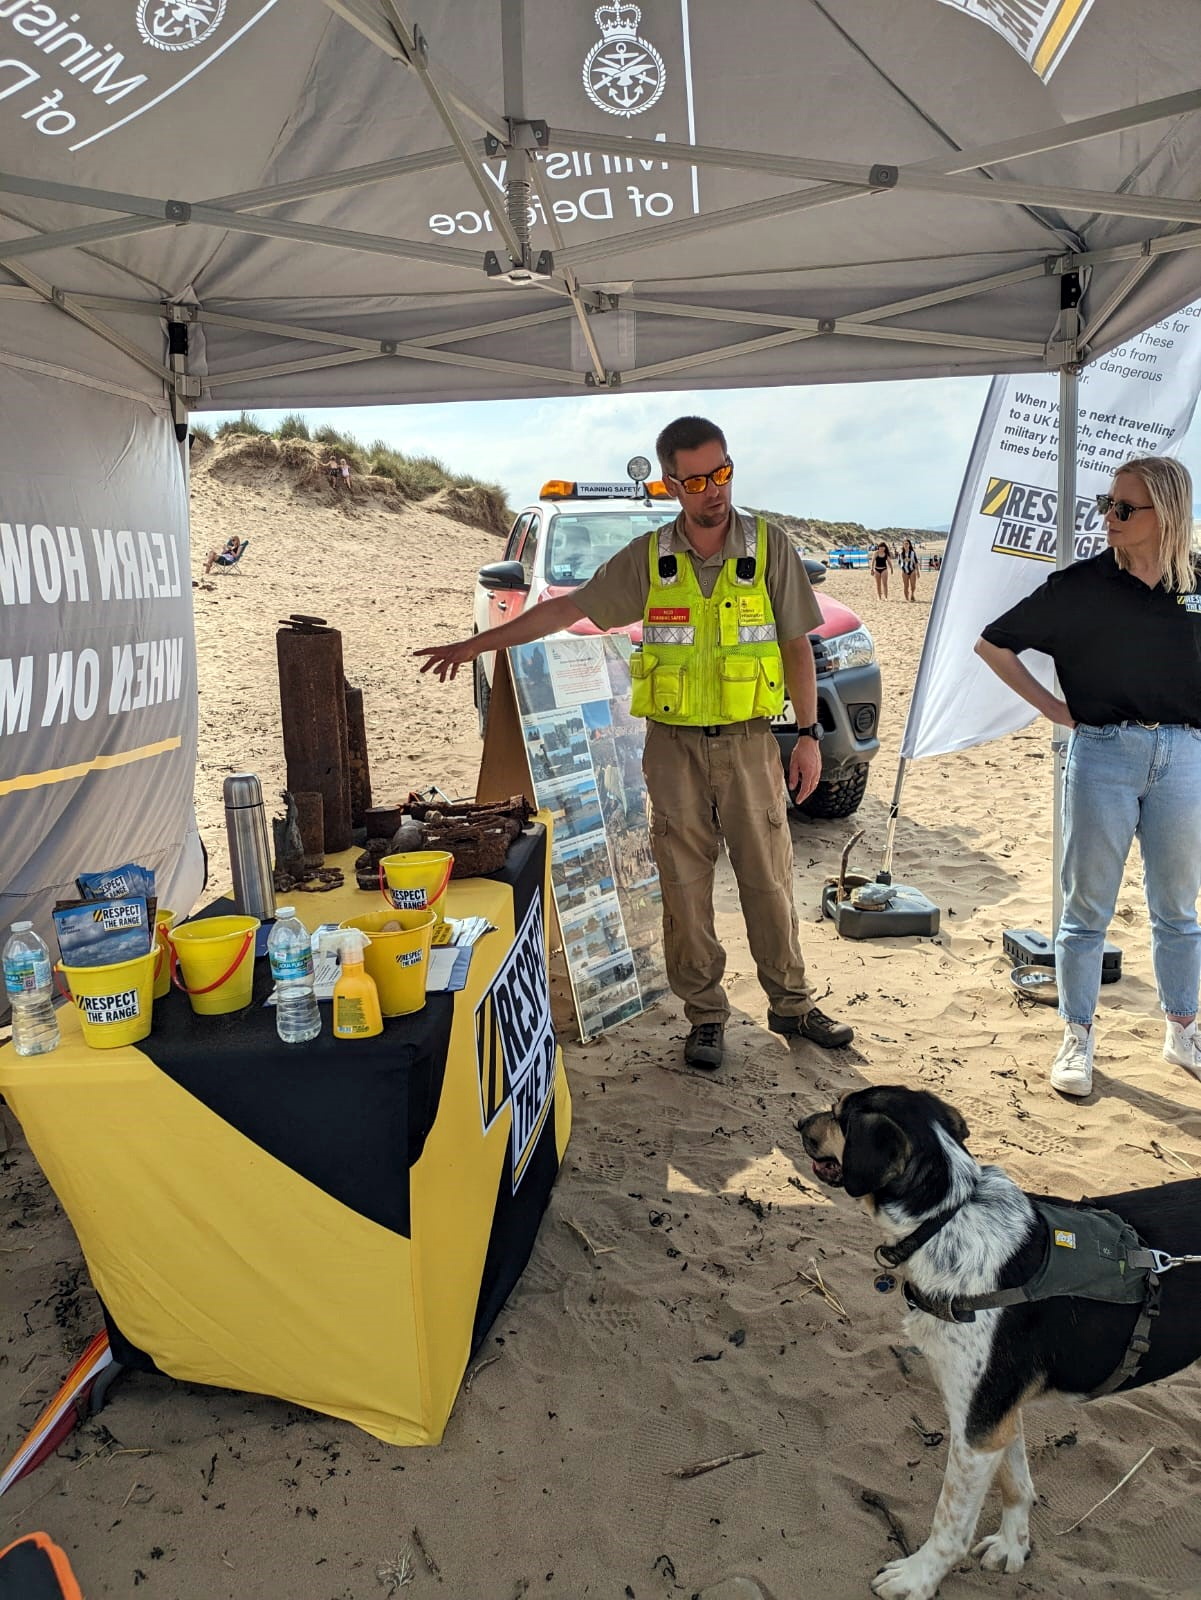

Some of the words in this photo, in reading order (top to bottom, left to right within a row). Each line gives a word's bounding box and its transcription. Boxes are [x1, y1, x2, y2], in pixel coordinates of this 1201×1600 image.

[1171, 320, 1190, 334] for
[1139, 332, 1174, 349] These
[1110, 348, 1127, 358] go
[1129, 349, 1157, 364] from
[1099, 360, 1163, 382] dangerous
[1015, 391, 1047, 409] When
[1089, 409, 1117, 425] next
[1009, 408, 1021, 420] to
[1023, 413, 1030, 422] a
[1033, 413, 1051, 428] UK
[1095, 428, 1134, 447] check
[1136, 436, 1157, 451] the
[1000, 439, 1030, 456] times
[1032, 446, 1058, 462] befo
[1004, 424, 1048, 446] military
[1100, 445, 1124, 460] and
[999, 521, 1036, 551] THE
[102, 904, 140, 920] RESPECT
[105, 919, 119, 929] THE
[120, 916, 140, 927] RANGE
[85, 990, 136, 1010] RESPECT
[88, 1012, 104, 1022] THE
[105, 1005, 137, 1022] RANGE
[516, 1054, 542, 1152] THE
